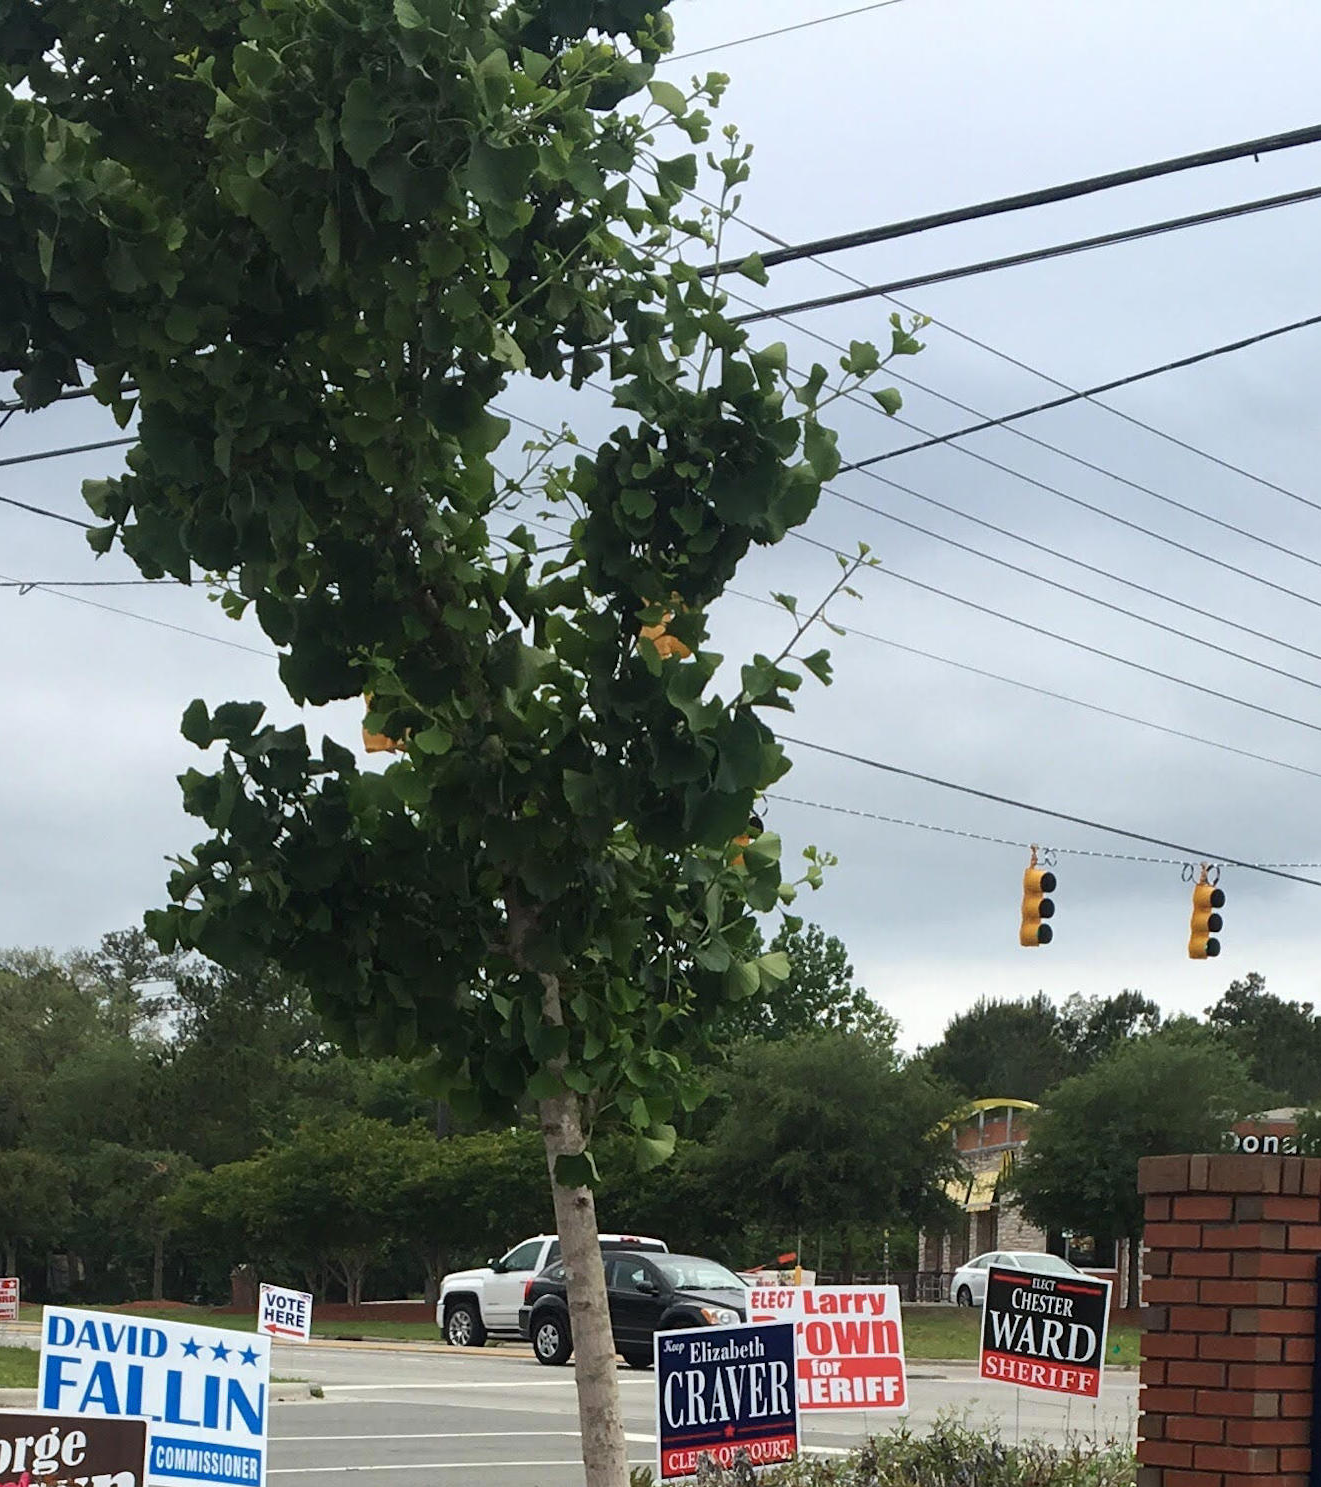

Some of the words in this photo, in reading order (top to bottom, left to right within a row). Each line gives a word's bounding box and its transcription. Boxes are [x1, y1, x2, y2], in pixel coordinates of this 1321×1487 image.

[1031, 1277, 1057, 1291] ELECT
[264, 1307, 305, 1328] HERE
[266, 1293, 306, 1313] VOTE
[751, 1290, 795, 1309] ELECT
[803, 1290, 886, 1315] Larry
[1011, 1287, 1074, 1318] CHESTER
[47, 1315, 168, 1358] DAVID
[689, 1335, 765, 1364] Elizabeth
[989, 1309, 1097, 1363] WARD
[810, 1360, 842, 1376] for
[985, 1355, 1094, 1392] SHERIFF
[44, 1354, 265, 1436] FALLIN
[663, 1360, 791, 1428] CRAVER
[155, 1445, 258, 1480] COMMISSIONER
